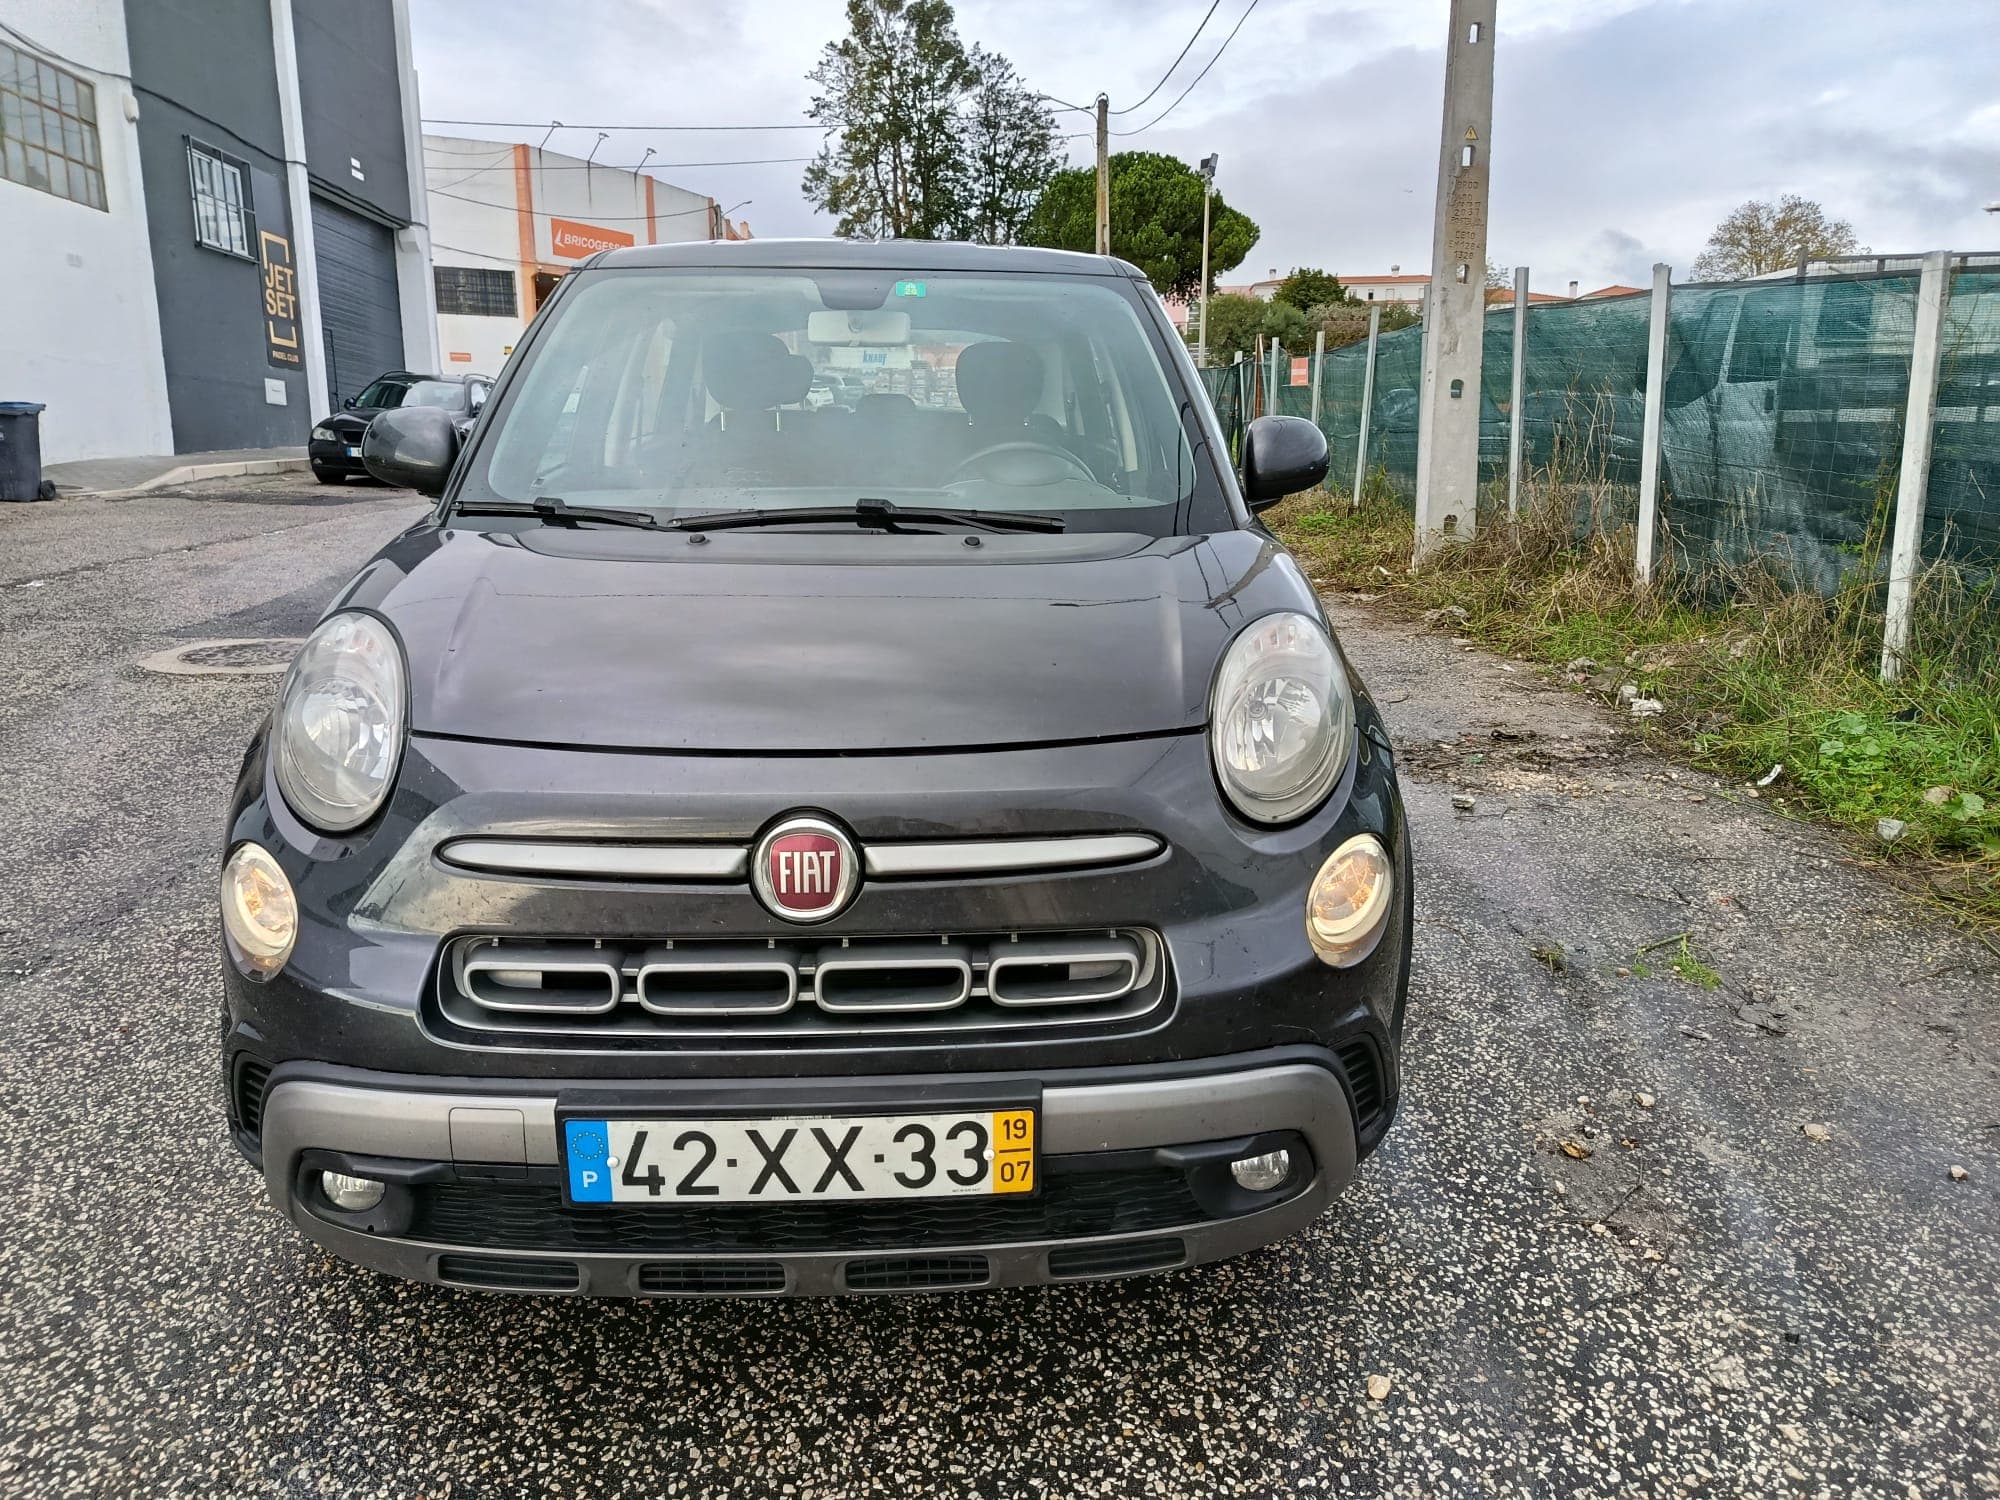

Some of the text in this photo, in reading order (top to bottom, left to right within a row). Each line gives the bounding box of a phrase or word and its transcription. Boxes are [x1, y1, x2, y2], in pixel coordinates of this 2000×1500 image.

[564, 233, 626, 250] BRICOGESS
[265, 262, 293, 294] JET
[266, 288, 295, 320] SET
[779, 851, 836, 894] FIAT
[1003, 1118, 1027, 1141] 19
[582, 1170, 599, 1188] P
[1000, 1160, 1031, 1183] 07
